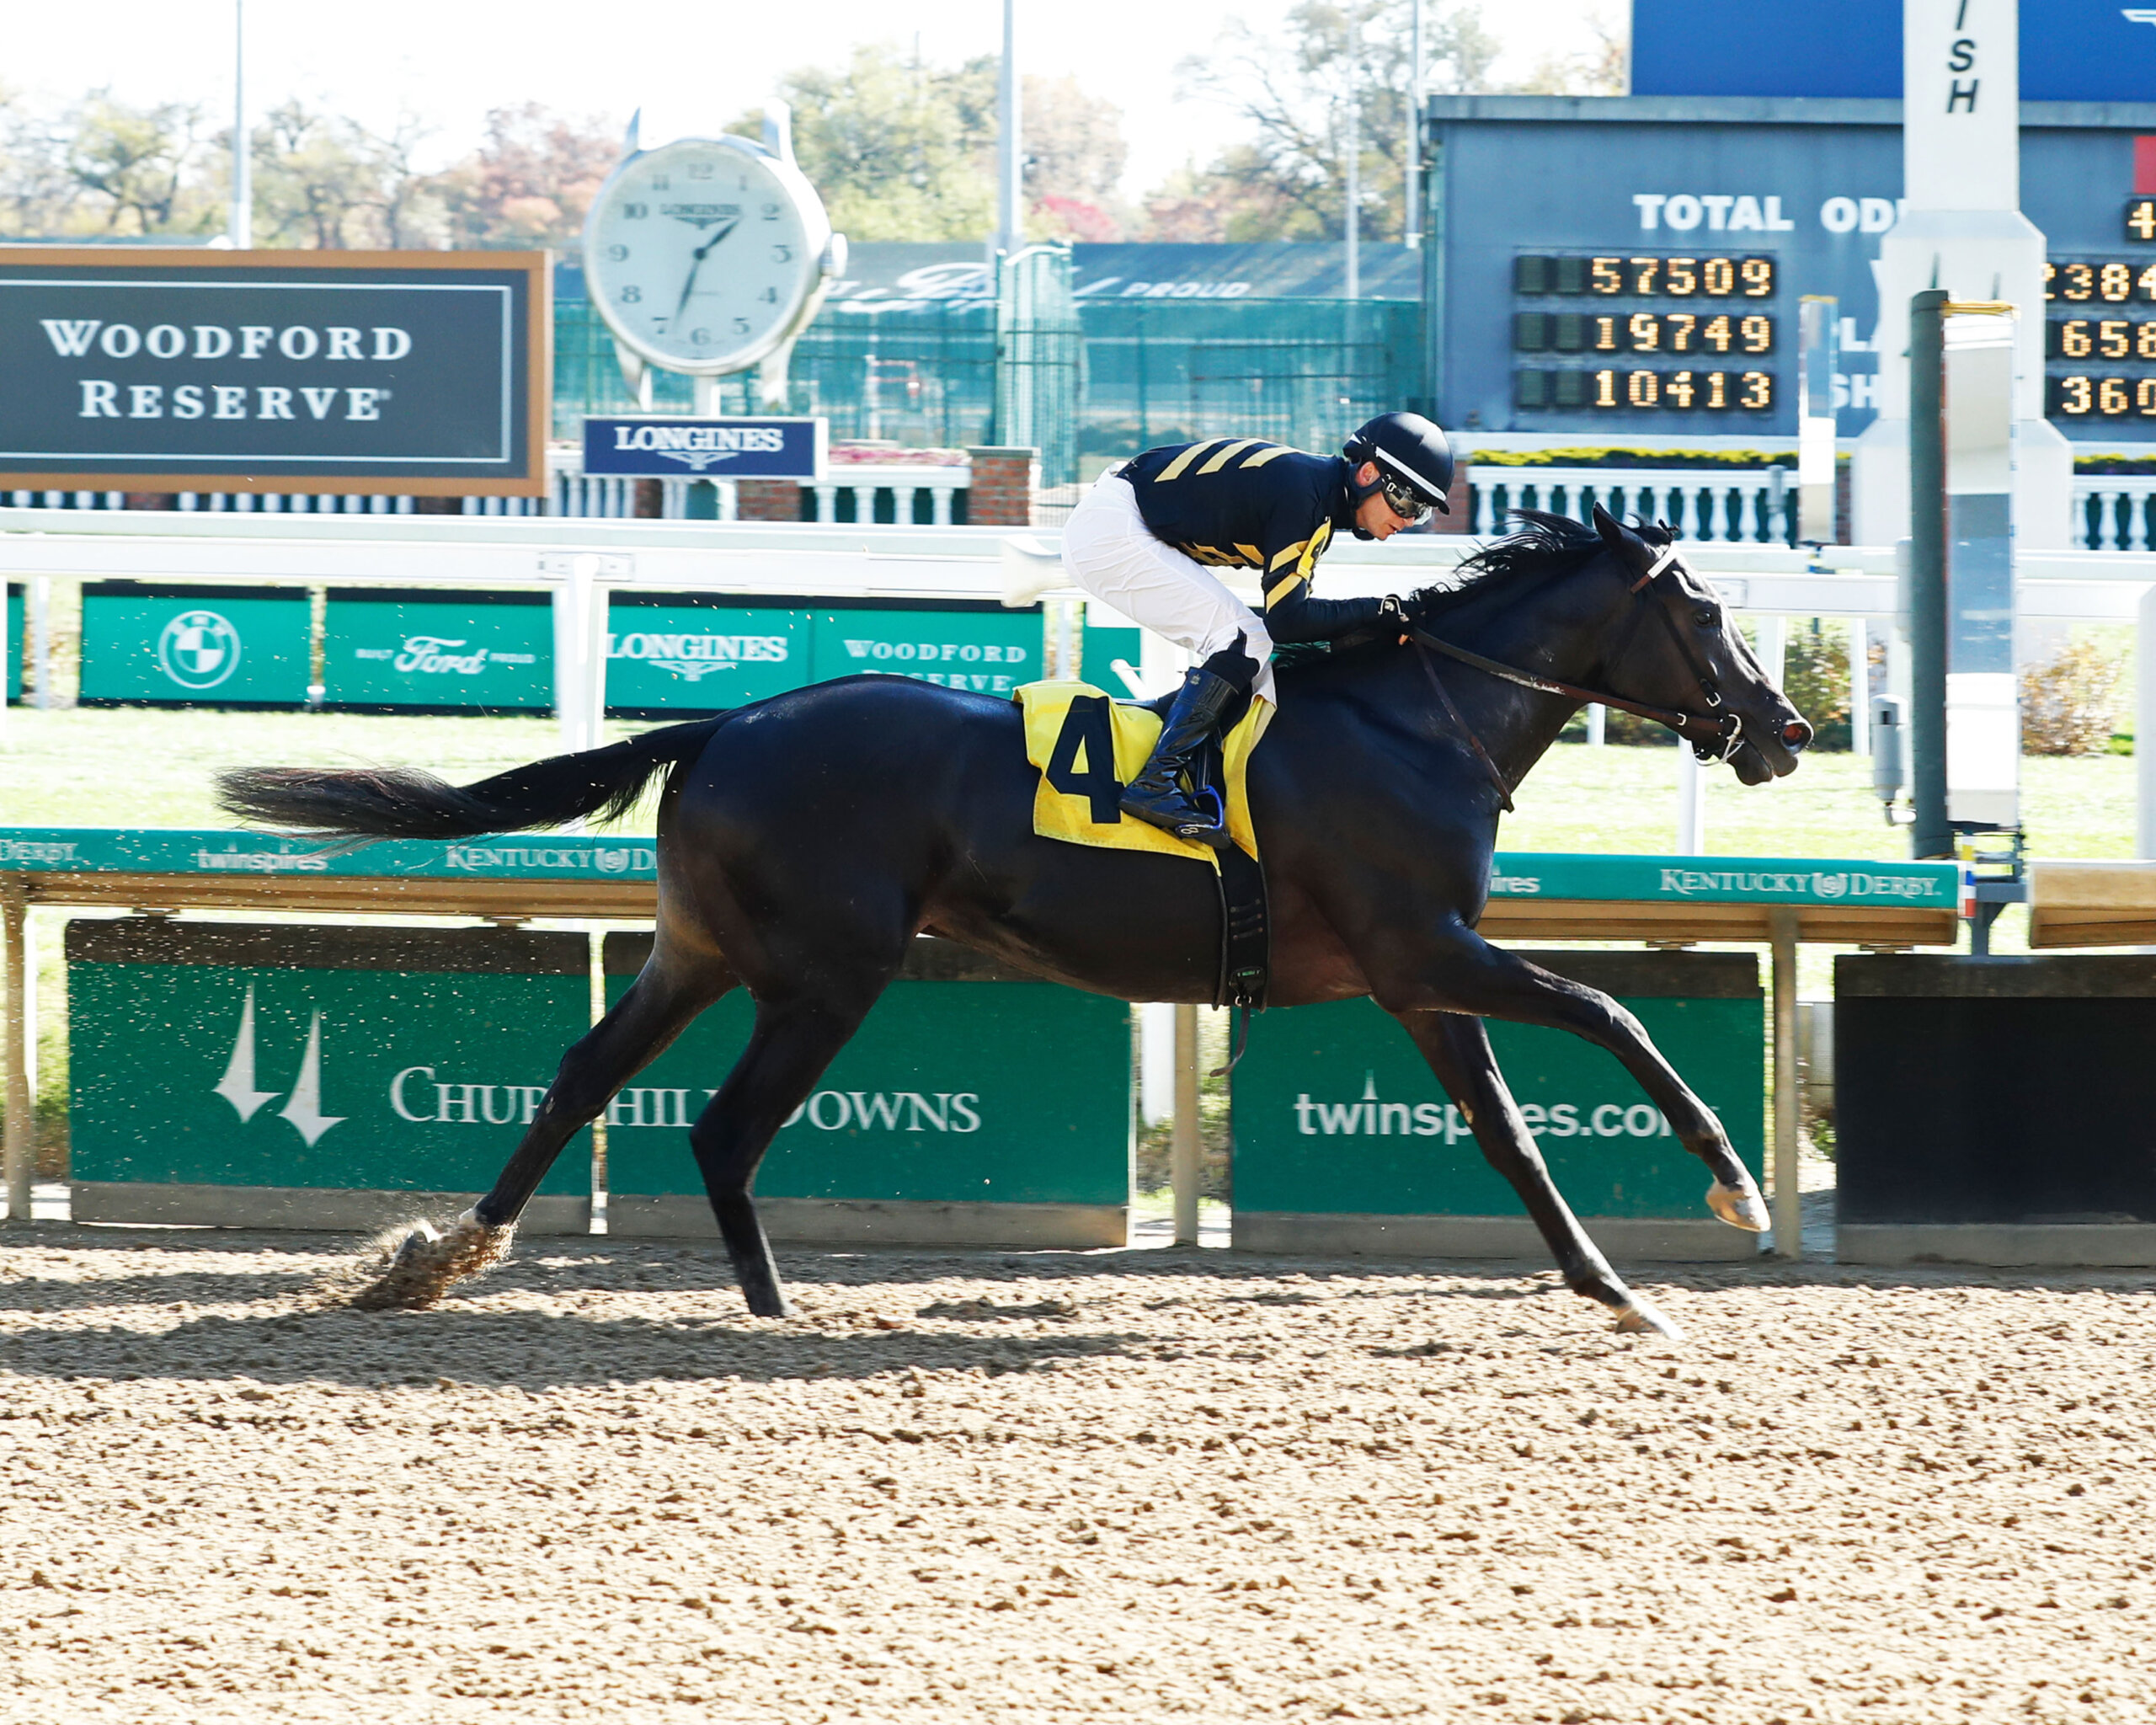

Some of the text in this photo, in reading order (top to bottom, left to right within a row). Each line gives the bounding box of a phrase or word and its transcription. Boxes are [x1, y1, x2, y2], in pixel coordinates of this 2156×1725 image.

[625, 205, 648, 218] 10
[761, 204, 779, 220] 2
[1632, 194, 1795, 232] TOTAL
[608, 244, 628, 260] 9
[772, 245, 792, 263] 3
[1593, 257, 1770, 296] 57509
[622, 286, 642, 303] 8
[758, 286, 776, 304] 4
[1120, 282, 1251, 298] PROUD
[651, 317, 669, 334] 7
[693, 328, 711, 346] 6
[734, 318, 750, 334] 5
[1595, 313, 1769, 351] 19749
[40, 319, 412, 360] WOODFORD
[79, 380, 381, 420] RESERVE
[1596, 370, 1769, 408] 10413
[615, 427, 784, 451] LONGINES
[393, 636, 489, 675] Ford
[606, 633, 789, 662] LONGINES
[843, 639, 1027, 663] WOODFORD
[1045, 695, 1125, 824] 4
[446, 845, 592, 871] KENTUCKY
[1659, 869, 1938, 899] KENTUCKY DERBY
